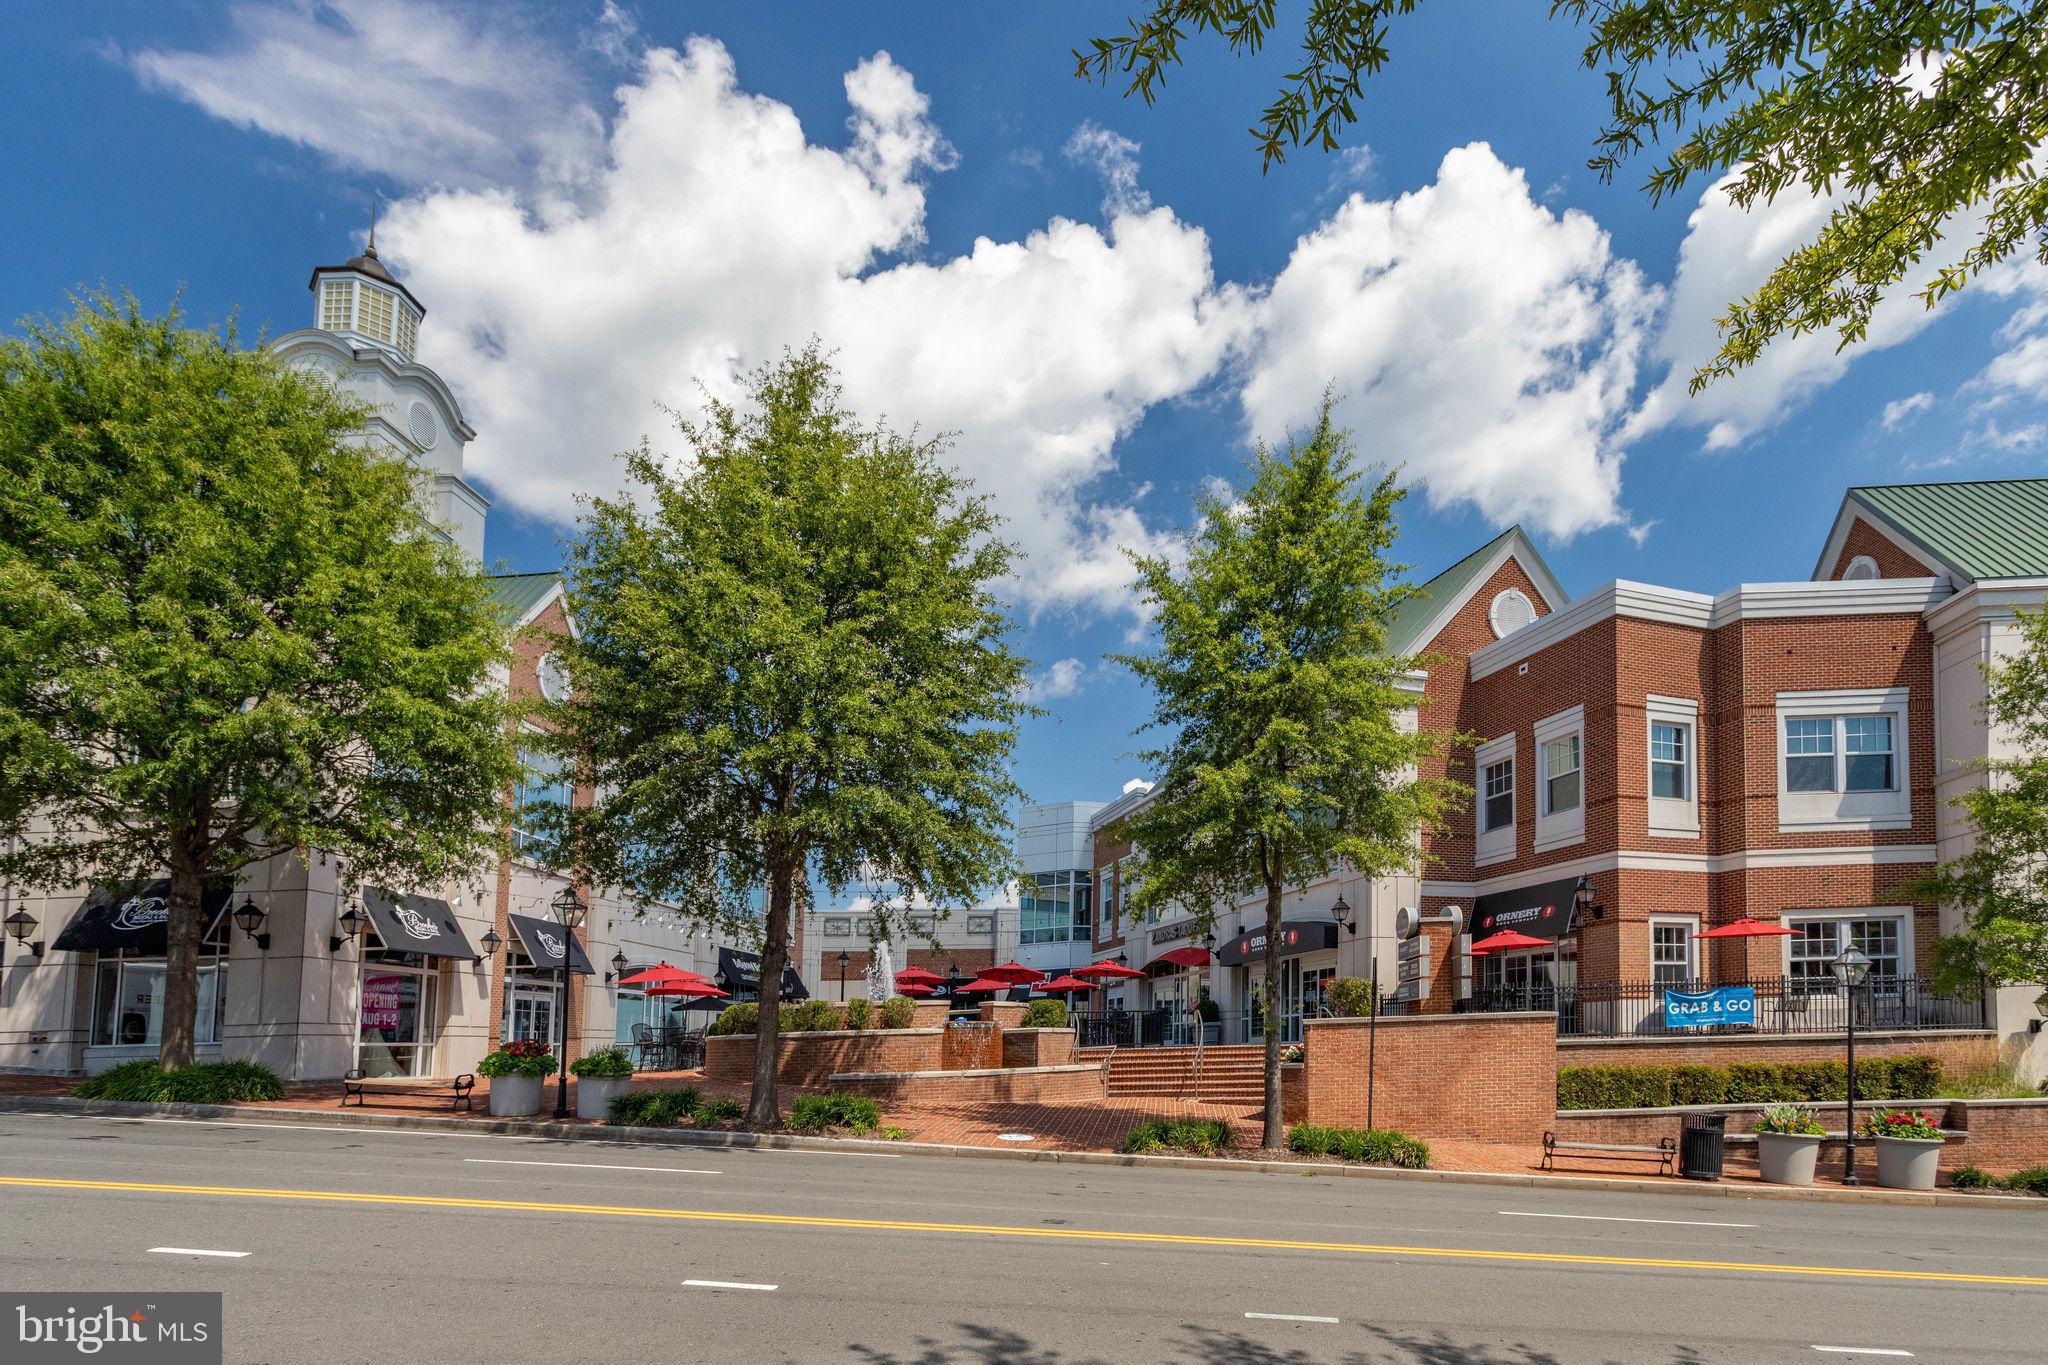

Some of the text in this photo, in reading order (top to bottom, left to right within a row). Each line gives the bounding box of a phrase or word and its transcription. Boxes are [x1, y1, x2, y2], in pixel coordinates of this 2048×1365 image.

[1496, 906, 1541, 922] ORNERY
[363, 992, 399, 1009] OPENING
[1668, 999, 1751, 1015] GRAB & GO
[362, 1012, 397, 1026] AUG 1-2
